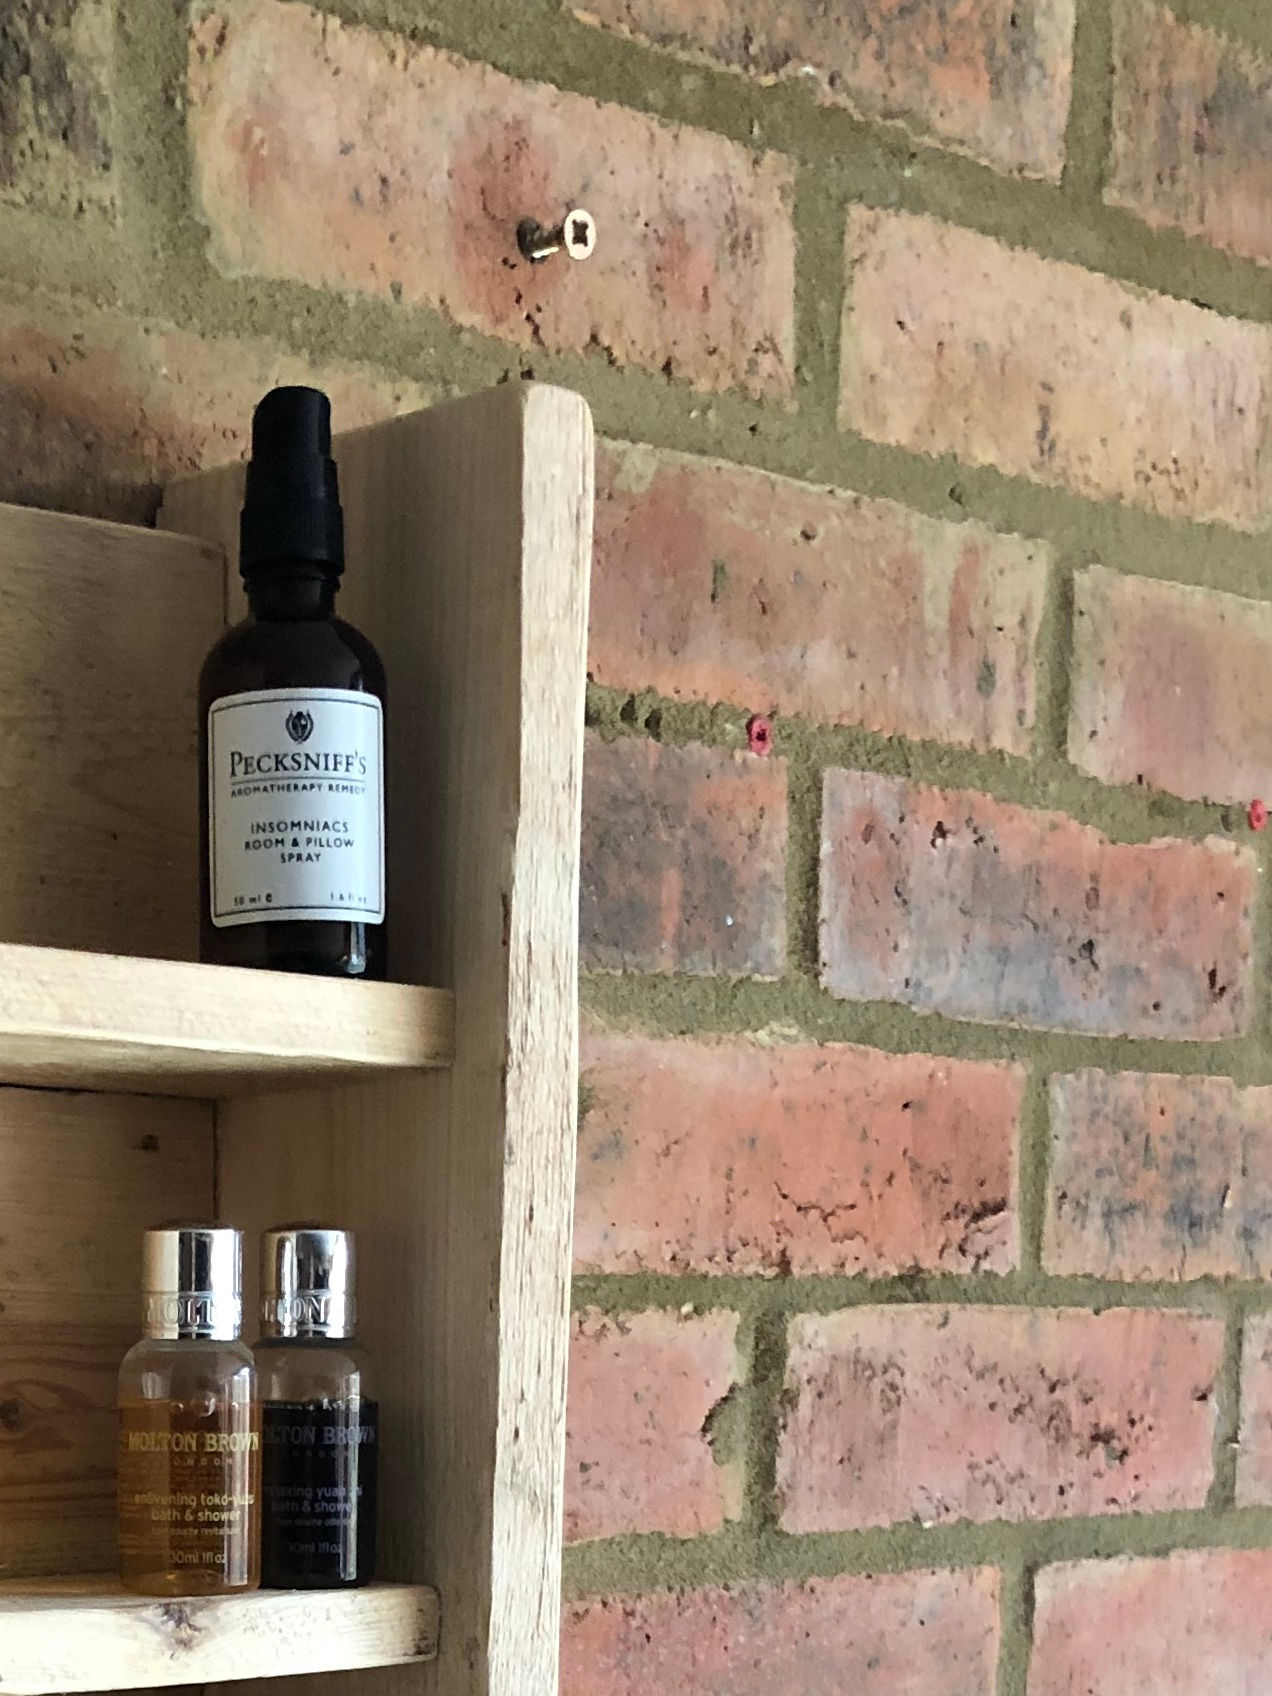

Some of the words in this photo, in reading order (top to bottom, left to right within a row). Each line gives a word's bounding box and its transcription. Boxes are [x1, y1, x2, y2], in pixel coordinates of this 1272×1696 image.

[230, 750, 366, 777] PECKSNIFF'S
[231, 784, 323, 797] AROMATHERAPY
[250, 820, 349, 834] INSOMNIACS
[244, 838, 285, 850] ROOM
[291, 837, 299, 848] &
[305, 837, 355, 848] PILLOW
[280, 853, 321, 864] SPRAY
[128, 1431, 198, 1452] MOLTON
[204, 1431, 260, 1452] BROWN
[264, 1424, 317, 1445] LTON
[302, 1498, 312, 1512] &
[314, 1499, 354, 1512] showe
[151, 1508, 181, 1521] bath
[184, 1509, 194, 1522] &
[197, 1509, 242, 1522] shower
